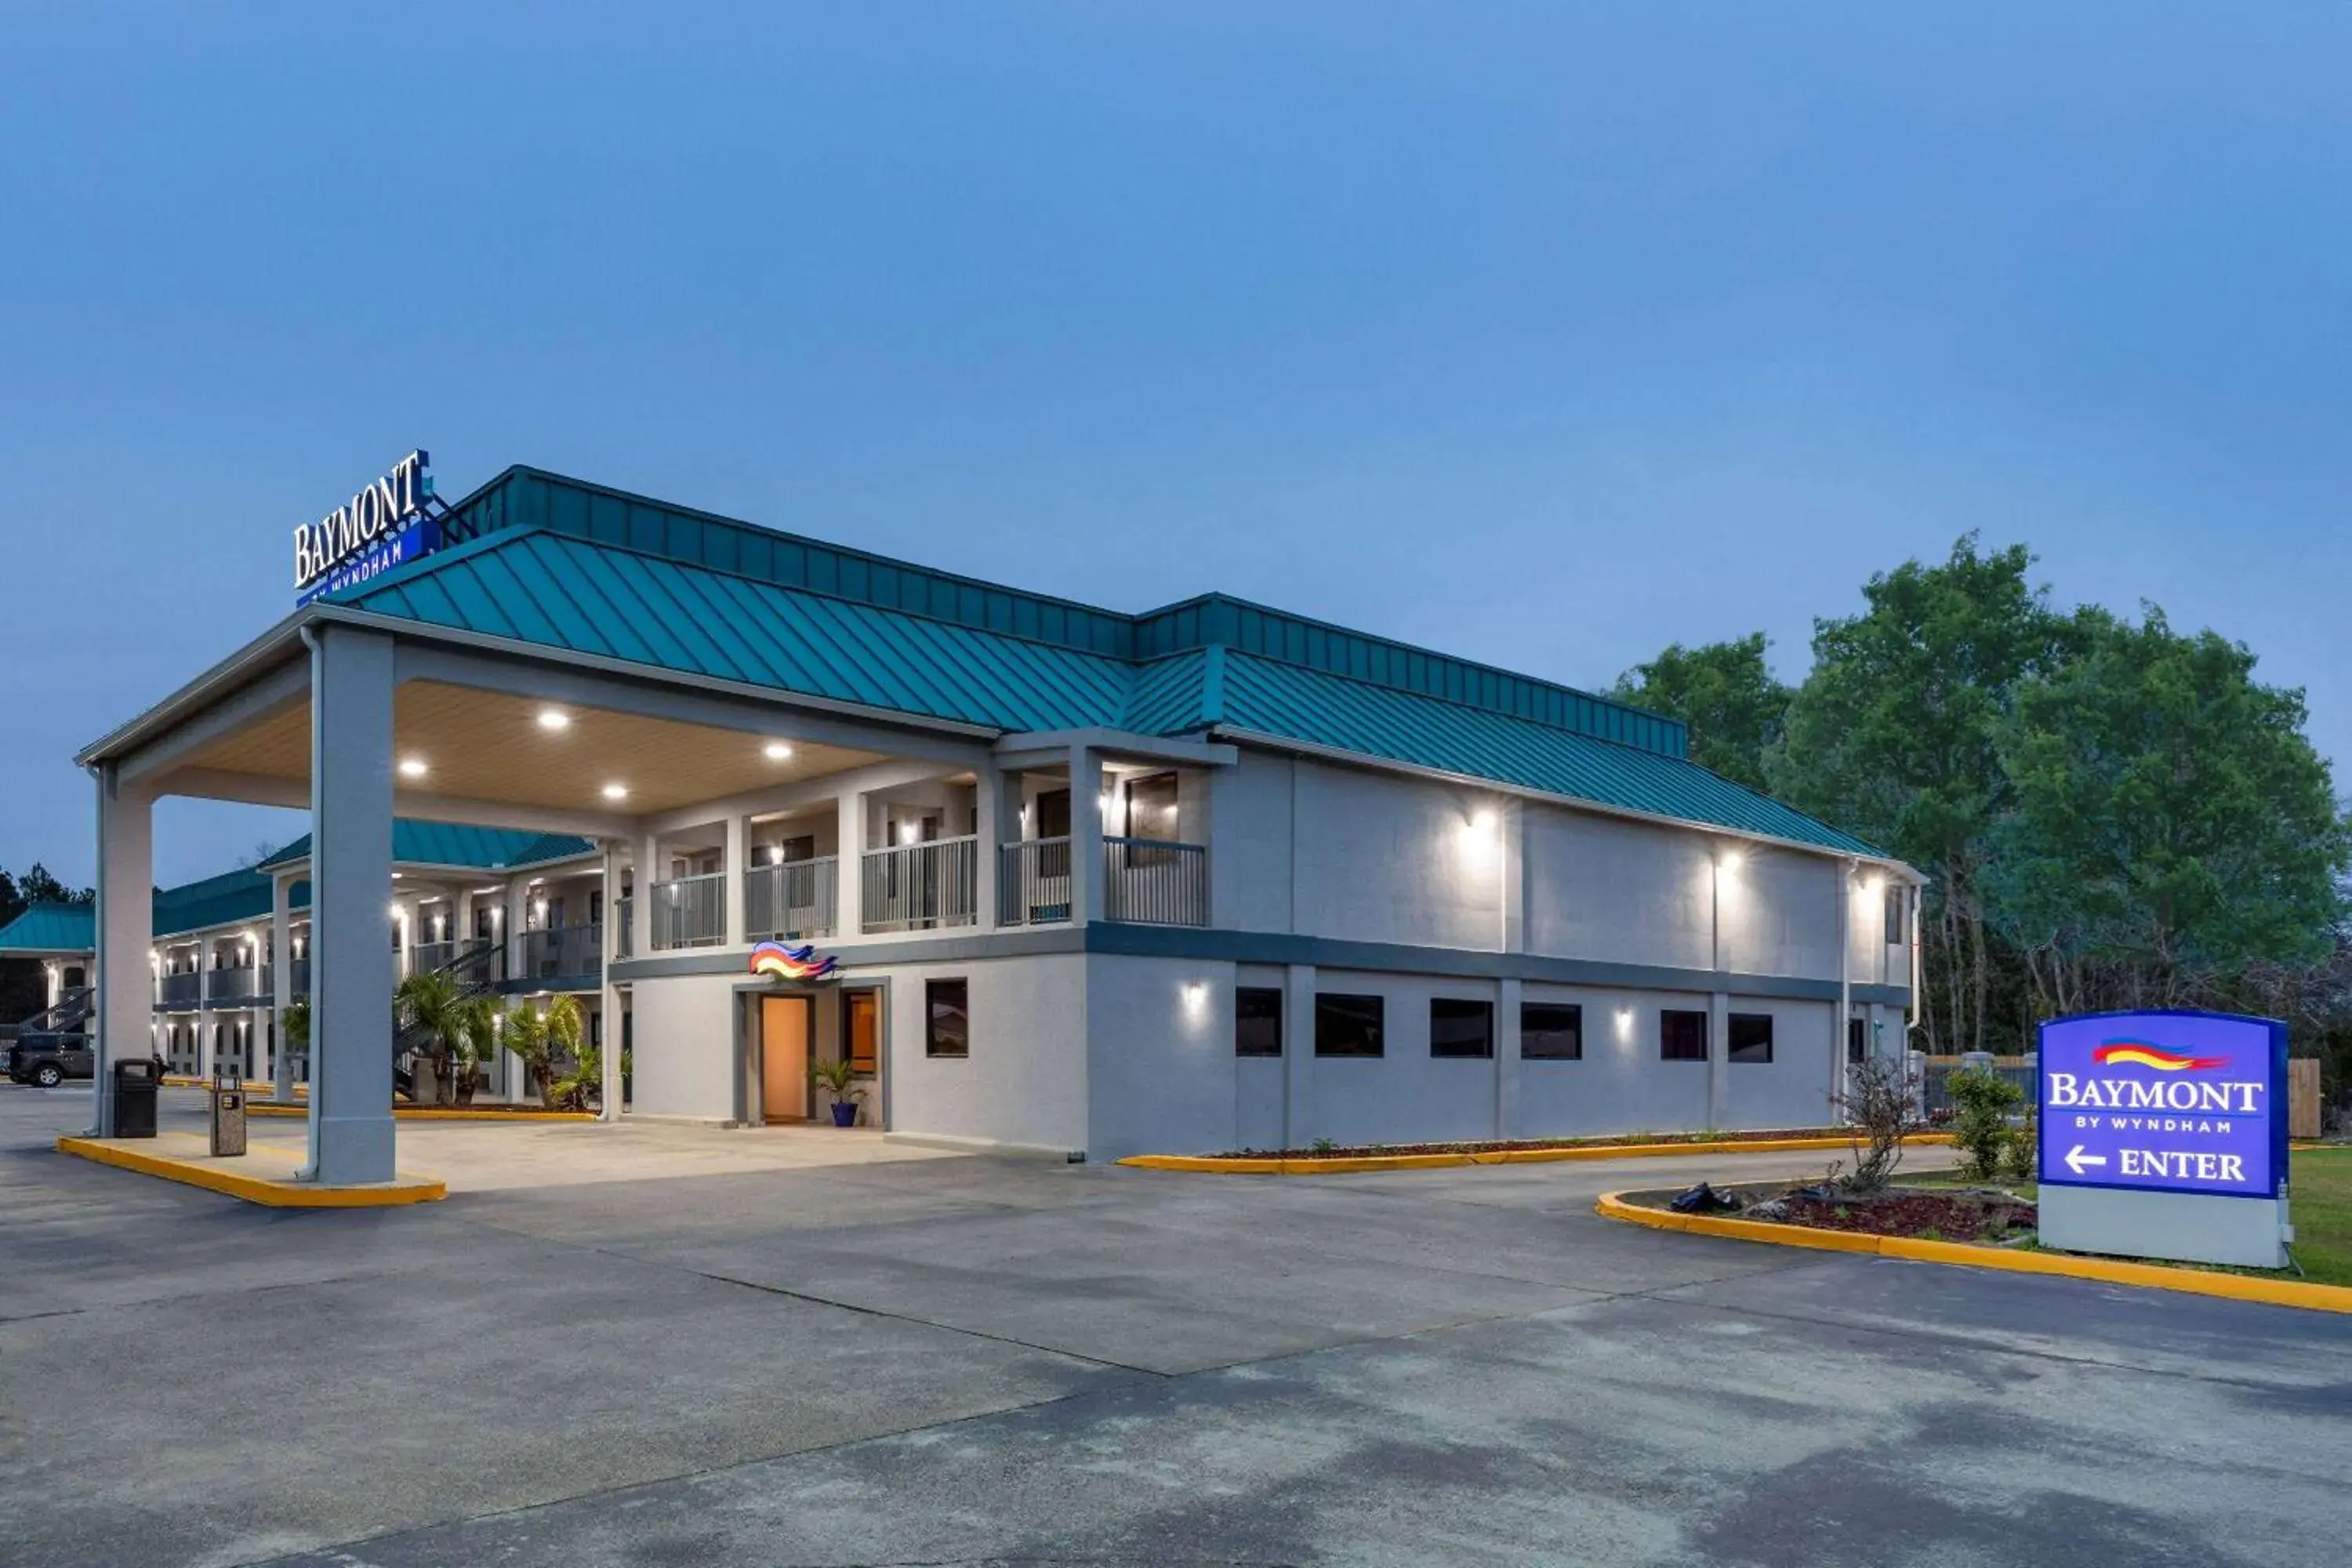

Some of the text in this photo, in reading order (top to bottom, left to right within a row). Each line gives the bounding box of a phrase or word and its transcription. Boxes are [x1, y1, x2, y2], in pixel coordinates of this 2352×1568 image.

[294, 450, 419, 589] BAYMONT
[332, 540, 401, 592] WYNDHAM
[2048, 1073, 2263, 1112] BAYMONT
[2076, 1116, 2231, 1133] BY WYNDHAM
[2119, 1149, 2246, 1181] ENTER
